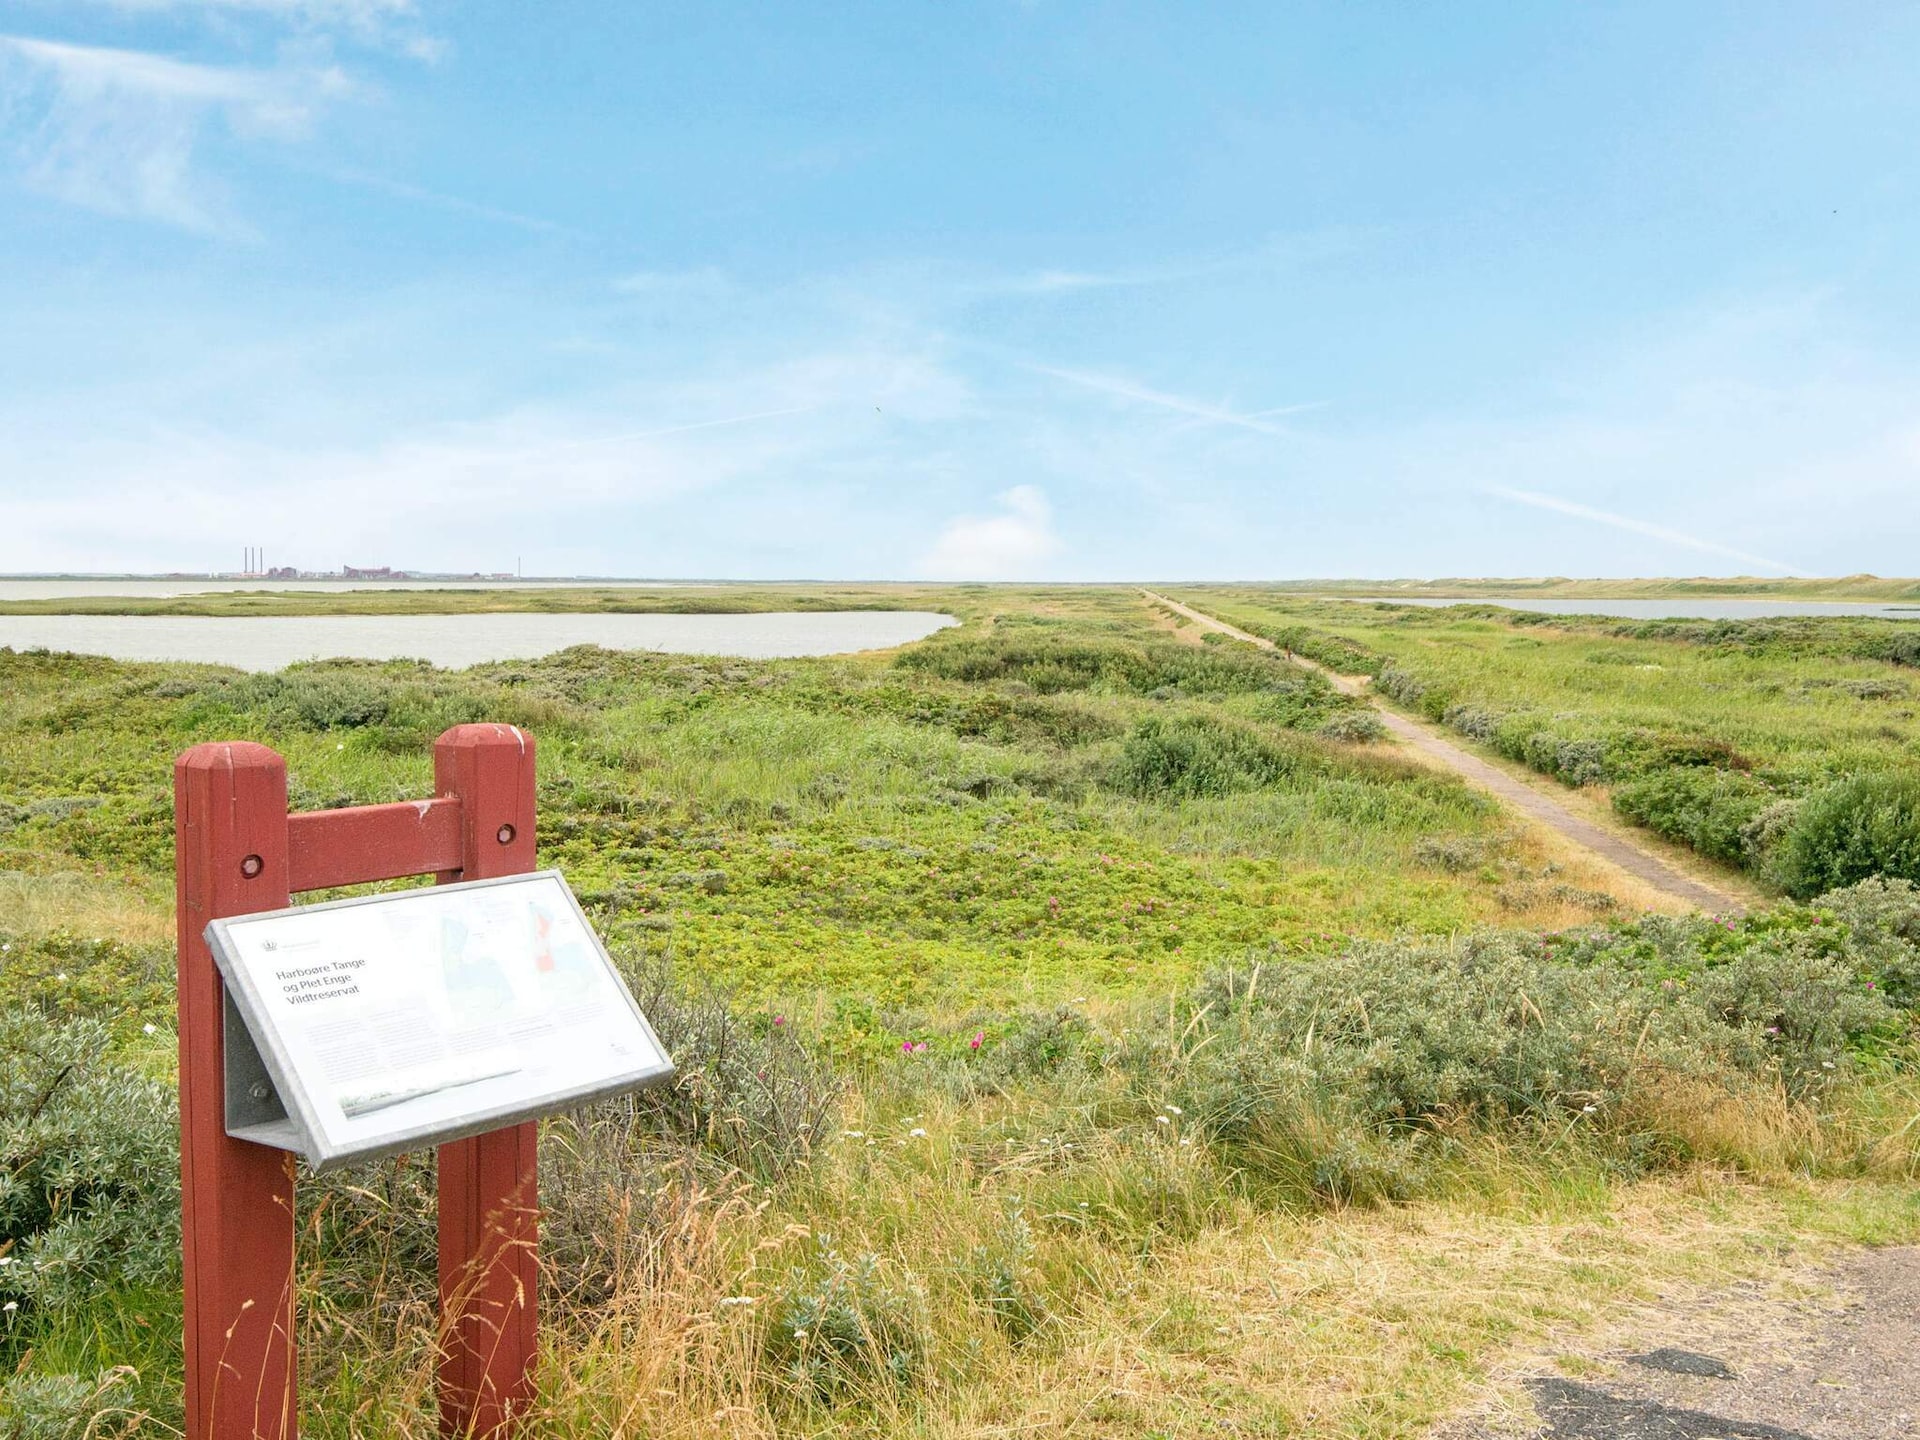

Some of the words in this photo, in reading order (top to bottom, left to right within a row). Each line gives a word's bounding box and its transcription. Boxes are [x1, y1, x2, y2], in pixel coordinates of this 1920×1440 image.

[275, 965, 331, 980] Harboøre
[331, 959, 366, 969] Tange
[283, 983, 299, 993] og
[299, 979, 322, 989] Plet
[323, 974, 352, 984] Enge
[286, 985, 360, 1005] Vildtreservat
